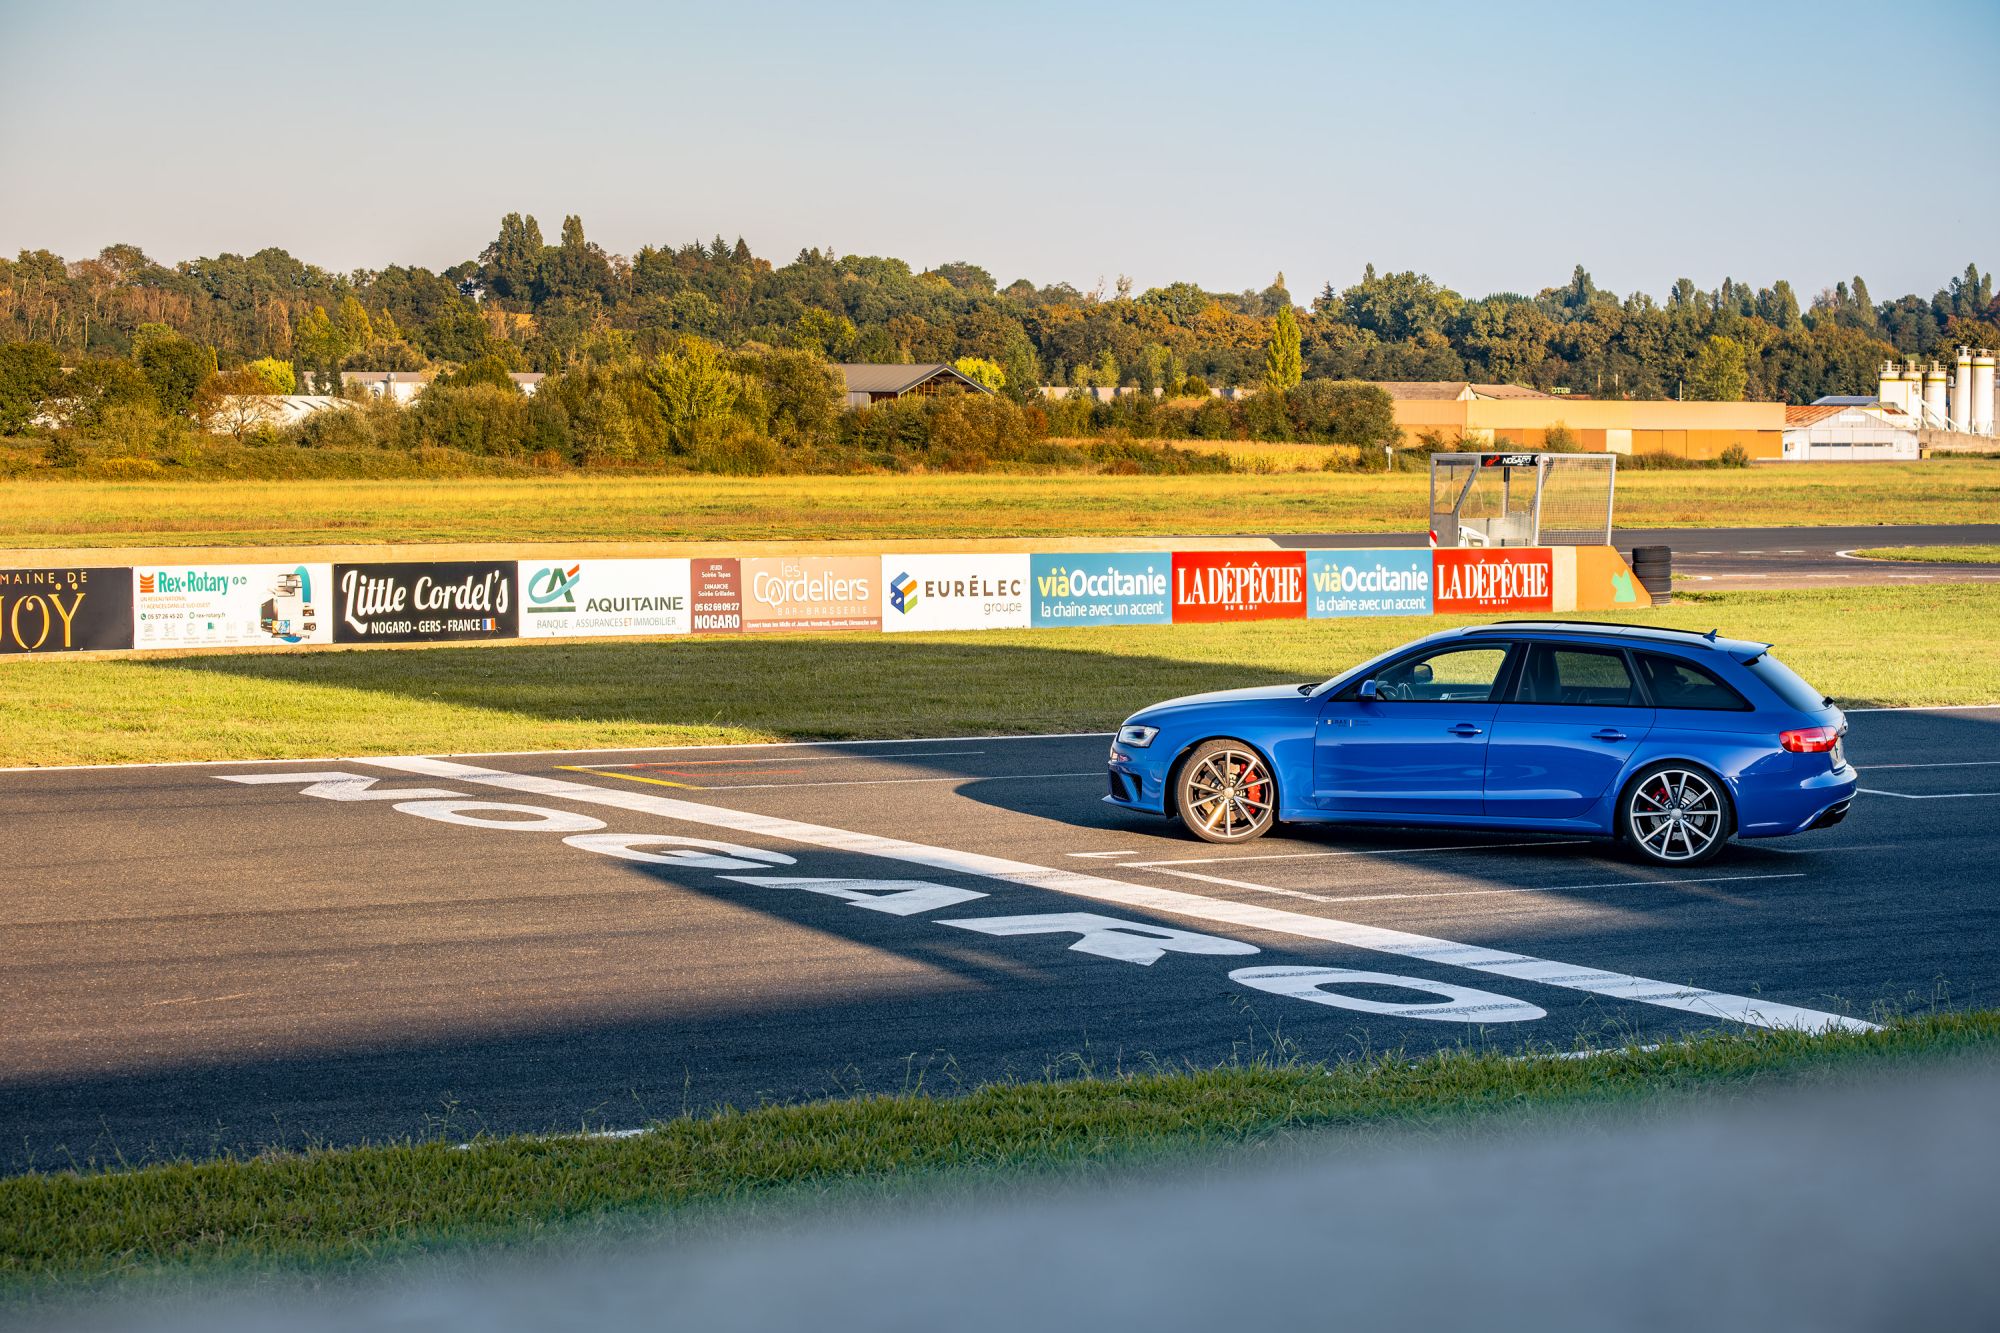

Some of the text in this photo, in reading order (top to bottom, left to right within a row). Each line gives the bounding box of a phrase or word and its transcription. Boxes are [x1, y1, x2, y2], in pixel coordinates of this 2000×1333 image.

[68, 572, 88, 583] DE
[717, 571, 732, 579] Tapas
[781, 560, 800, 578] les
[925, 574, 1021, 598] EURÉLEC
[1037, 566, 1167, 598] viàOccitanie
[1207, 561, 1302, 604] DÉPÊCHE
[1312, 563, 1429, 593] viàOccitanie
[1464, 557, 1549, 599] DÉPÊCHE
[753, 571, 869, 608] Cordeliers
[342, 570, 508, 634] Little Cordel's
[585, 596, 684, 613] AQUITAINE
[695, 602, 740, 612] 05 62 69 09 27
[983, 602, 1022, 616] groupe
[1041, 600, 1165, 618] la chaîne avec un accent
[1316, 595, 1427, 612] la chaîne avec un accent
[371, 620, 411, 634] NOGARO
[418, 619, 441, 633] GERS
[447, 618, 481, 632] FRANCE
[576, 618, 623, 629] ASSURANCES
[624, 617, 633, 627] ET
[634, 616, 677, 627] IMMOBILIER
[694, 614, 740, 629] NOGARO
